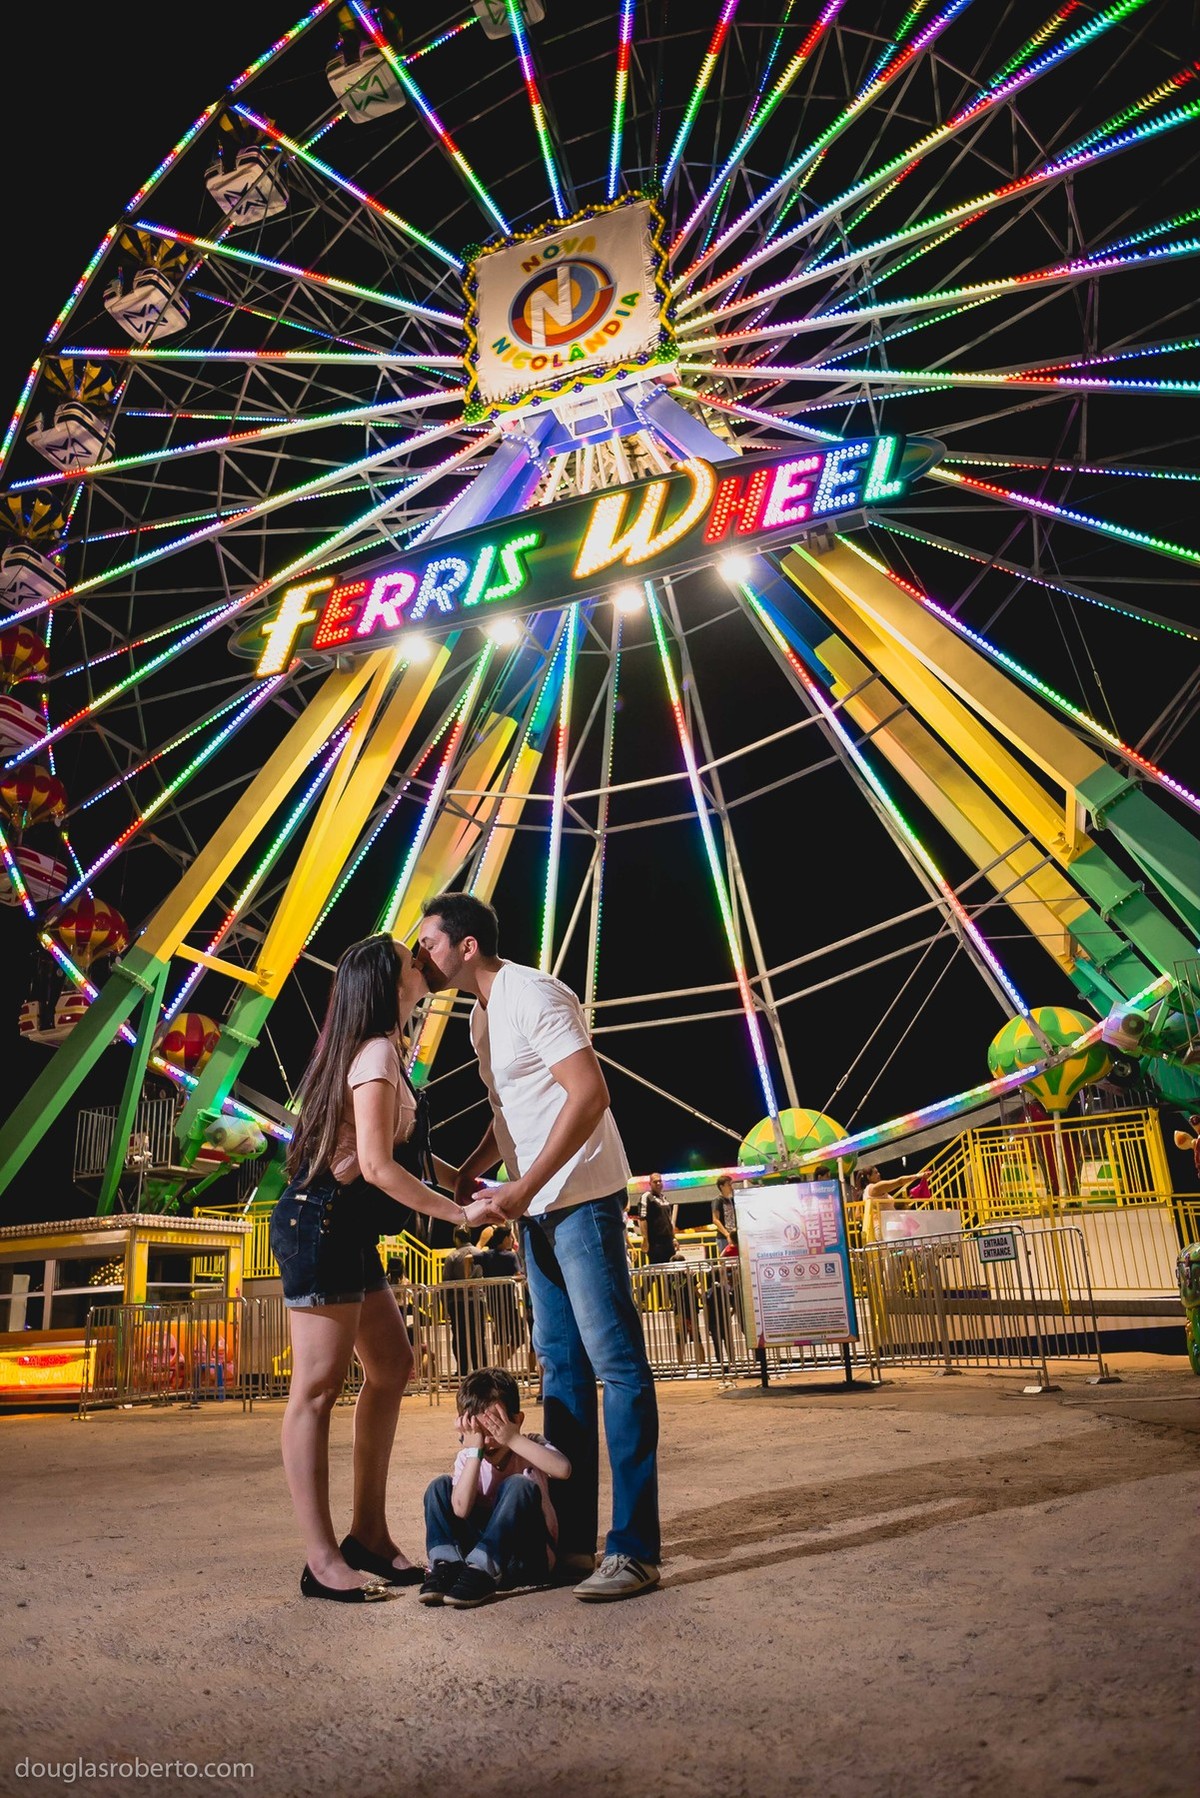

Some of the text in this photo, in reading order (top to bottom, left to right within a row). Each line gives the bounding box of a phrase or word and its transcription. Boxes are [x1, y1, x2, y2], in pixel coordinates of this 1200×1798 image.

[520, 235, 597, 275] NOVA
[254, 433, 904, 678] FERRIS WHEEL
[819, 1194, 838, 1246] WHEEL
[983, 1247, 1011, 1258] ENTRANCE
[984, 1237, 1008, 1248] ENTRADA
